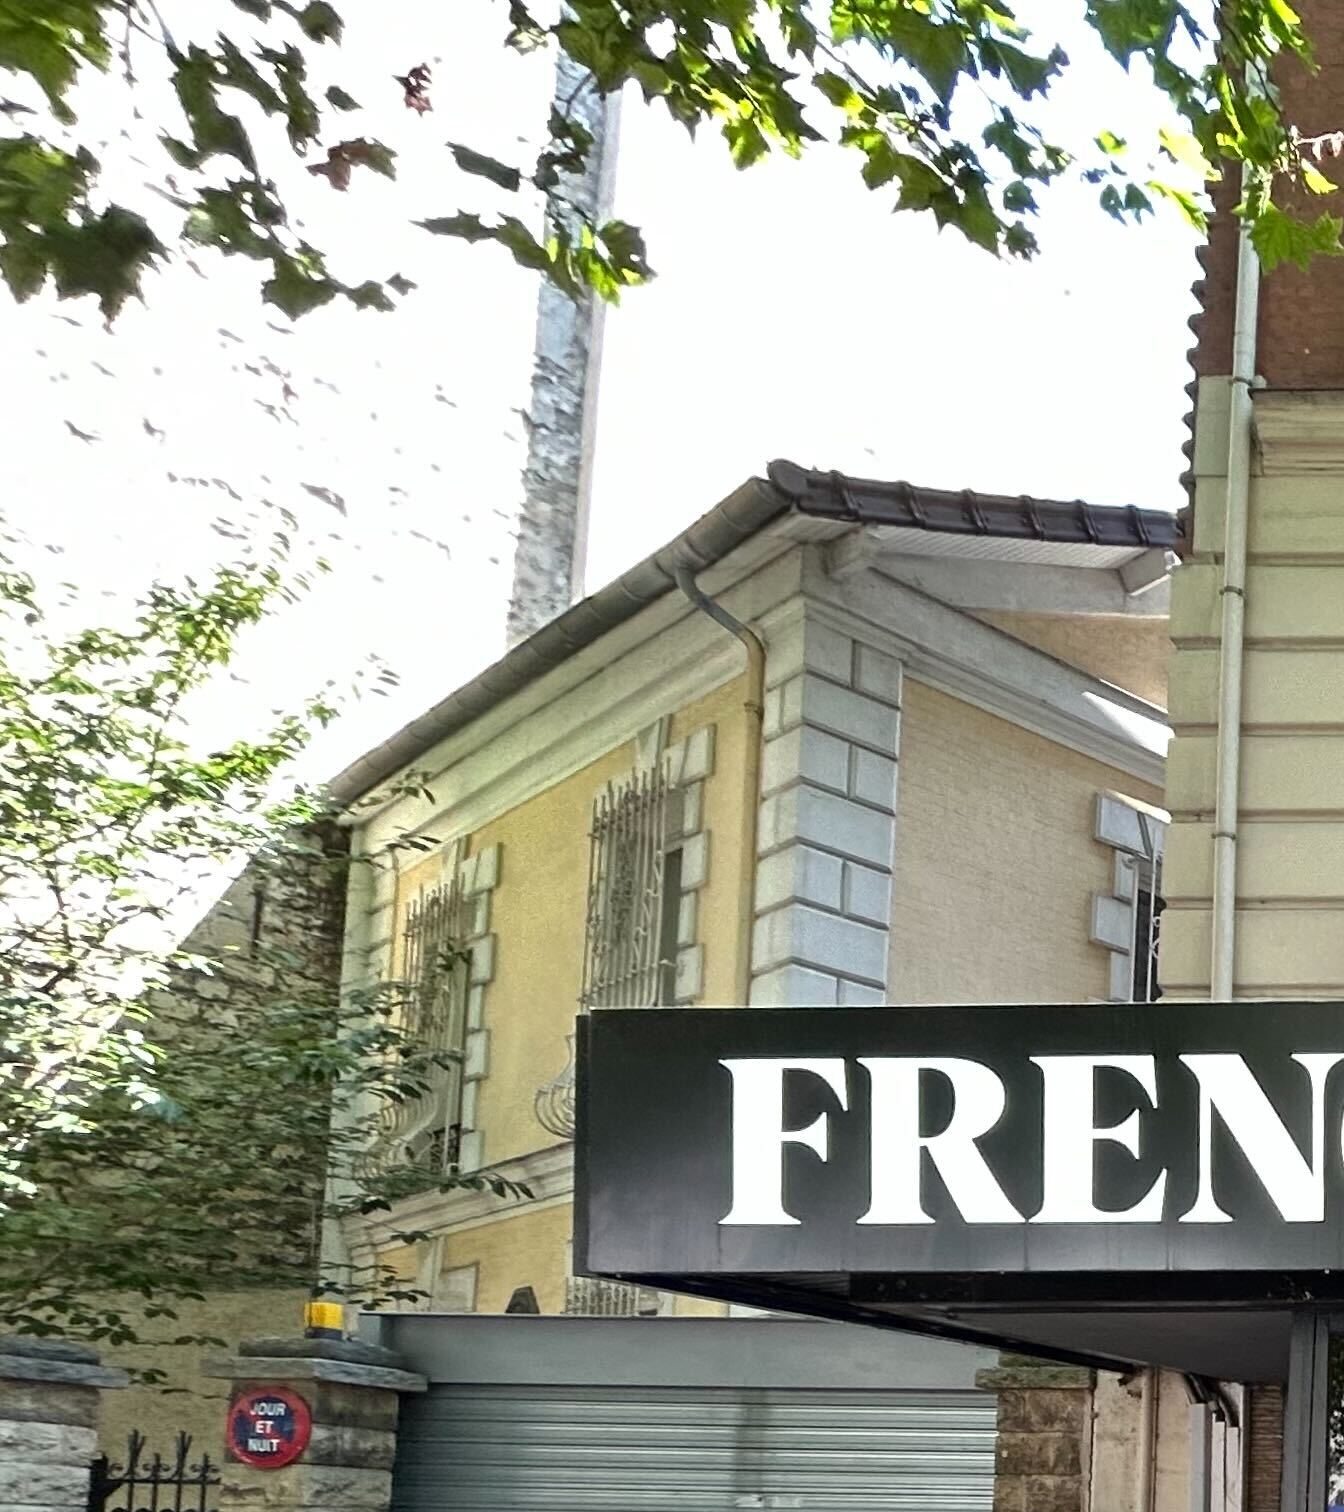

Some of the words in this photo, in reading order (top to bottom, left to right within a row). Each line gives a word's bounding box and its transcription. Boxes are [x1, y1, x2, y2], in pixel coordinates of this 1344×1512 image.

[250, 1402, 286, 1416] JOUR
[255, 1420, 274, 1434] ET
[247, 1438, 281, 1452] NUIT
